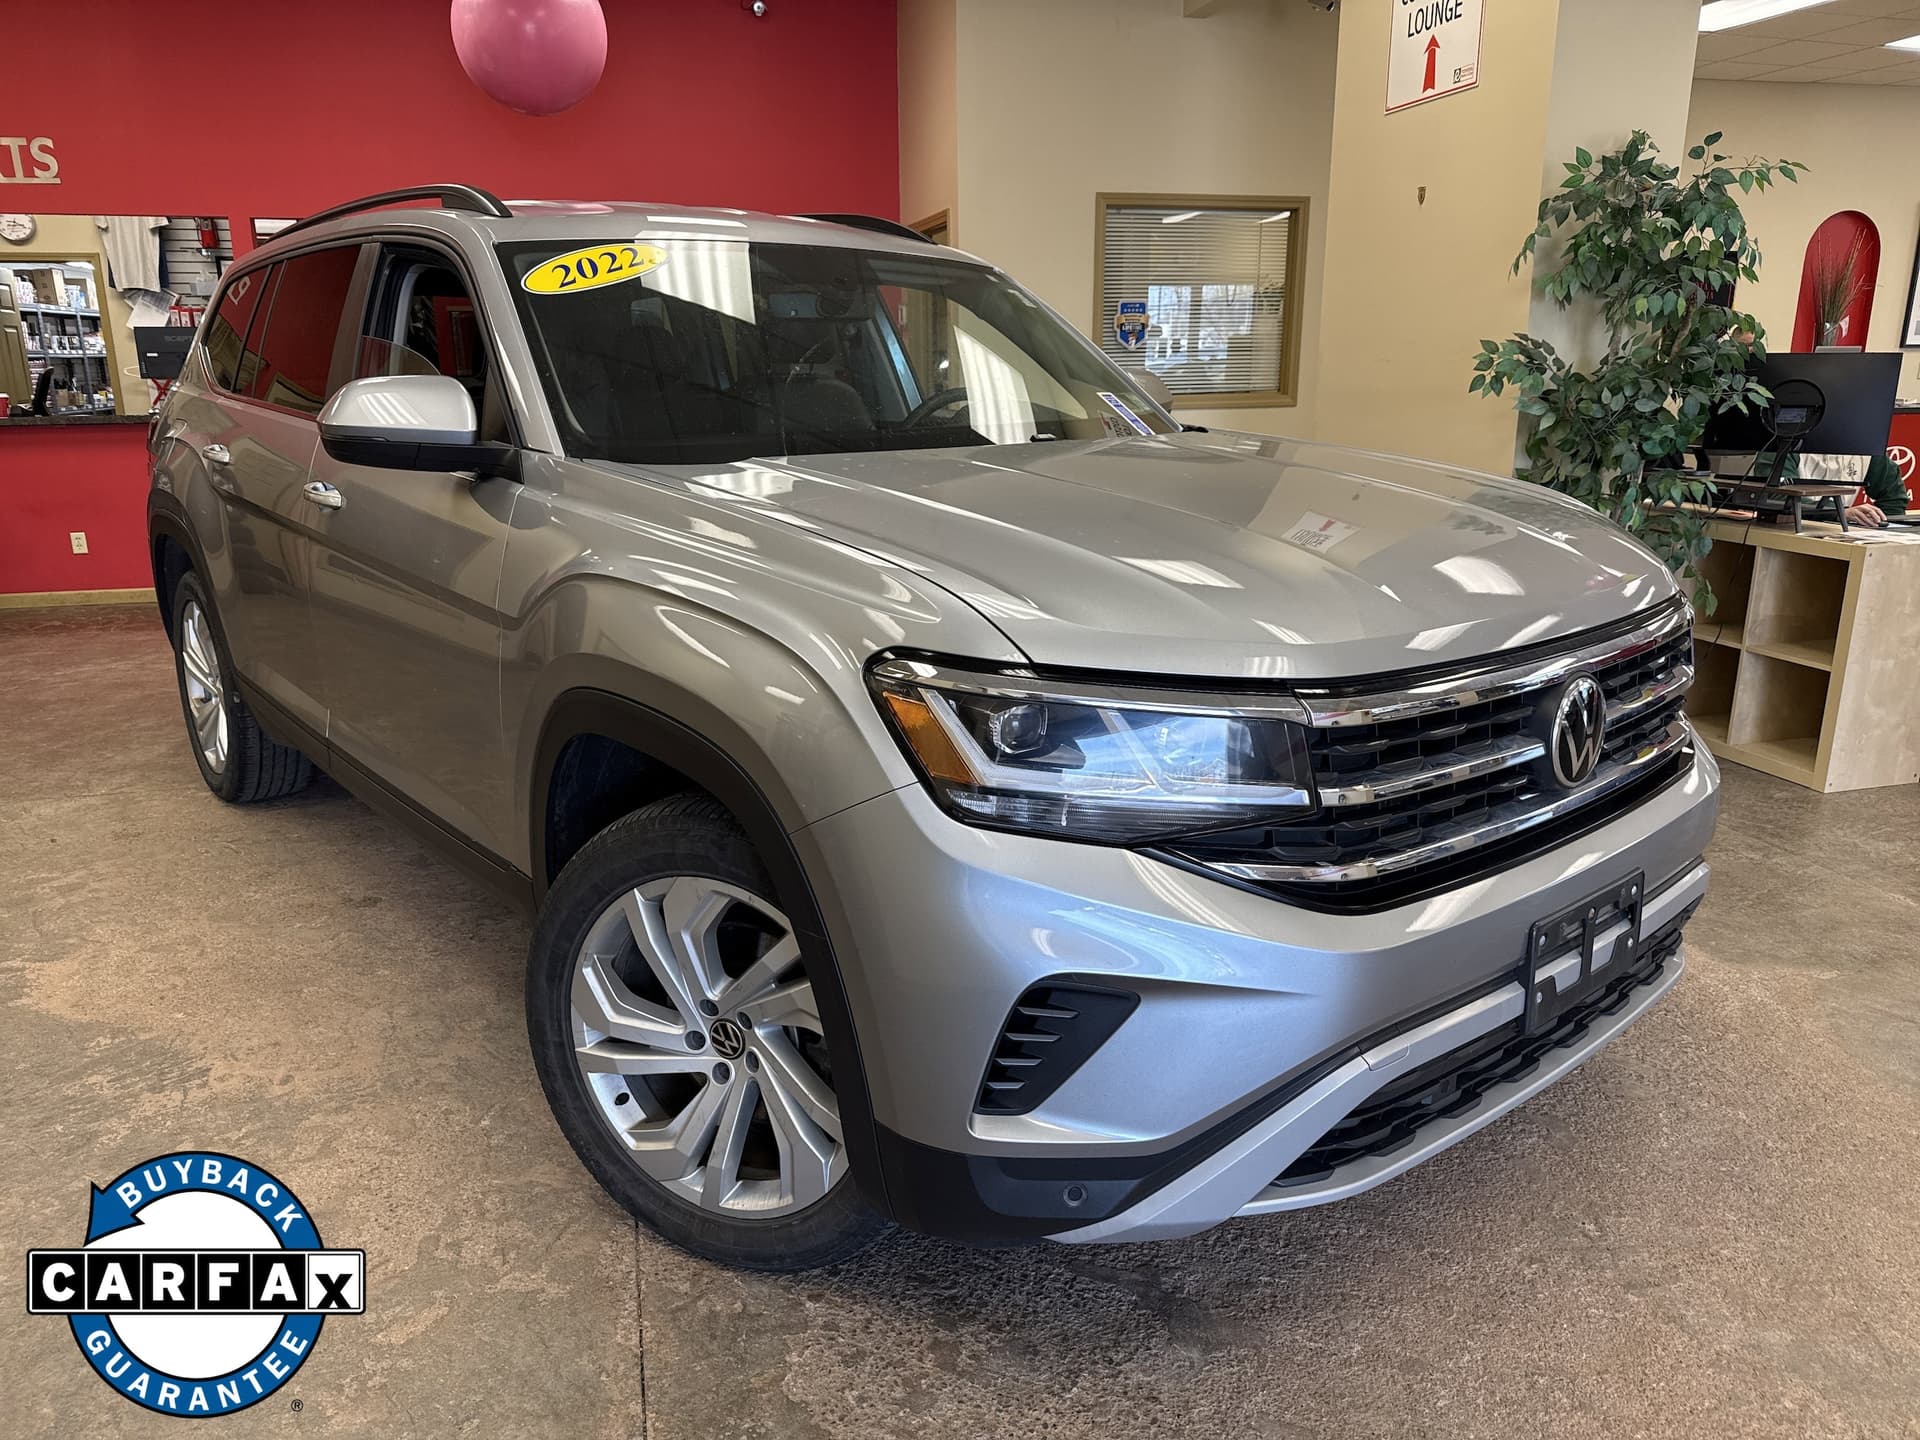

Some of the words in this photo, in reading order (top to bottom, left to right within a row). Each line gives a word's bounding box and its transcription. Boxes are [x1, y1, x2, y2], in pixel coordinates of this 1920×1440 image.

[1408, 0, 1463, 37] LOUNGE
[0, 136, 60, 181] TS
[551, 247, 645, 288] 2022
